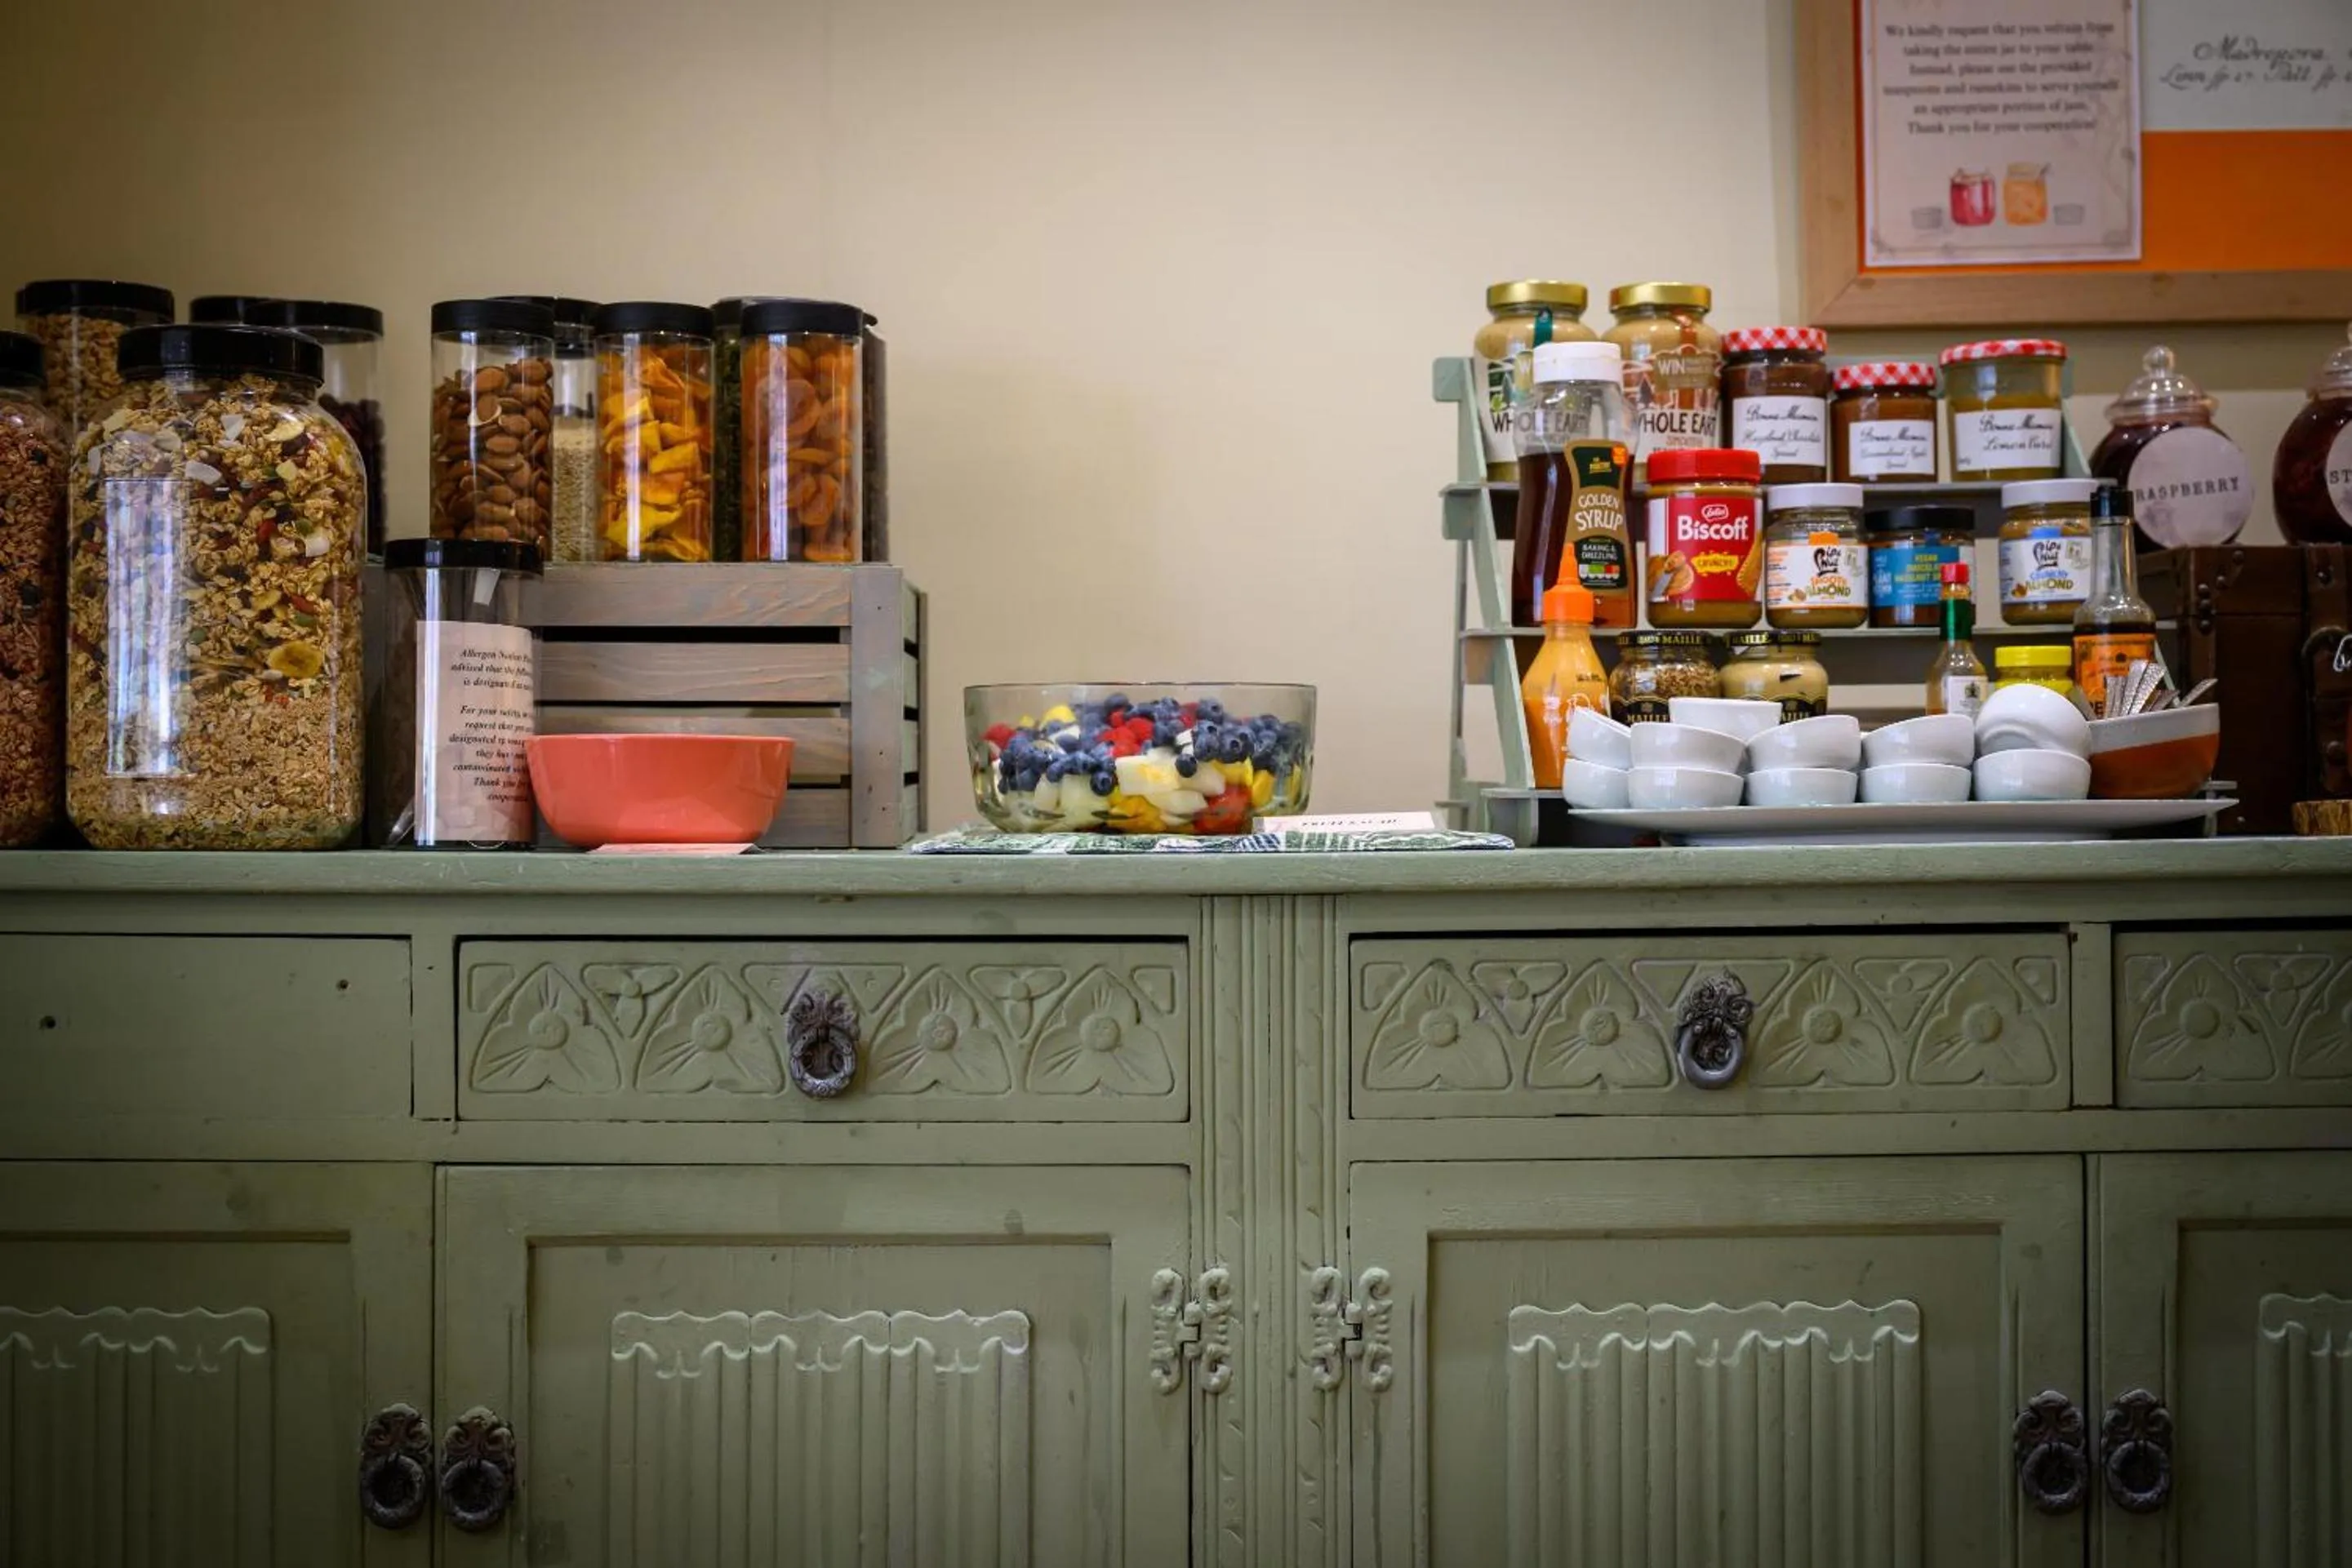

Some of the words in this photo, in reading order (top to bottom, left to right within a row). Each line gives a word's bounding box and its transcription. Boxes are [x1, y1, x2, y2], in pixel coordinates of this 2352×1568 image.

[1908, 24, 1943, 38] kindly
[1993, 22, 2016, 34] that
[2020, 25, 2040, 38] you
[1944, 44, 1961, 56] the
[2019, 44, 2032, 55] to
[2034, 45, 2061, 56] your
[1997, 65, 2016, 74] use
[2019, 63, 2038, 74] the
[1944, 82, 1966, 95] and
[2025, 82, 2038, 93] to
[1914, 104, 1927, 115] an
[2049, 98, 2061, 113] of
[1907, 122, 1945, 135] Thank
[1949, 124, 1972, 135] you
[1974, 120, 1990, 133] for
[1994, 122, 2021, 135] your
[1658, 358, 1686, 375] WIN
[1492, 411, 1550, 433] WHOE
[2135, 475, 2240, 503] RASPBERRY
[1577, 492, 1621, 509] GOLDEN
[1574, 509, 1624, 531] SYRUP
[1677, 515, 1749, 541] Biscoff
[460, 704, 475, 714] For
[477, 708, 497, 717] your
[465, 722, 496, 731] request
[449, 732, 496, 744] designated
[474, 776, 500, 787] Thank
